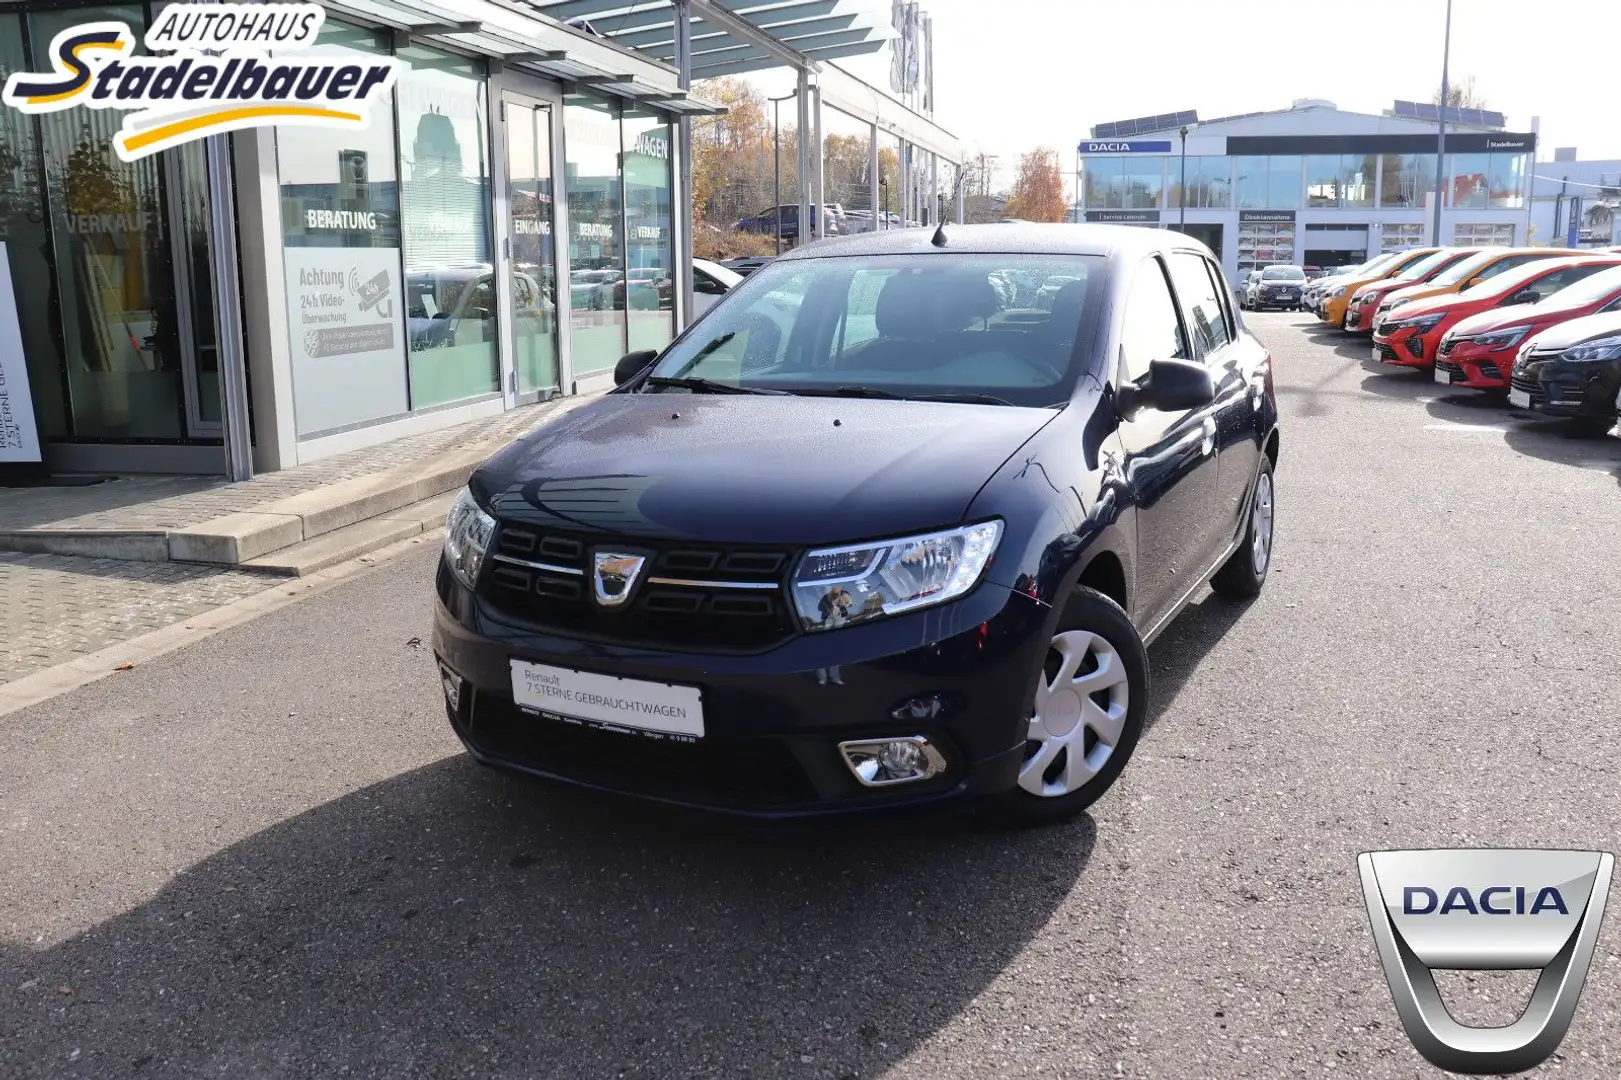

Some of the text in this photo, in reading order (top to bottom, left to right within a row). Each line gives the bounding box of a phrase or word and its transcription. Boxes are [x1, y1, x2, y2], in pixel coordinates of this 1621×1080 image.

[1088, 142, 1131, 152] DACIA
[63, 212, 152, 234] VERKAUF
[307, 209, 377, 230] BERATUNG
[515, 219, 551, 235] EINGANG
[579, 222, 613, 238] BERATUNG
[299, 267, 344, 289] Achtung
[524, 669, 561, 685] Renault
[526, 682, 687, 718] 7 STERNE GEBRAUCHTWAGEN
